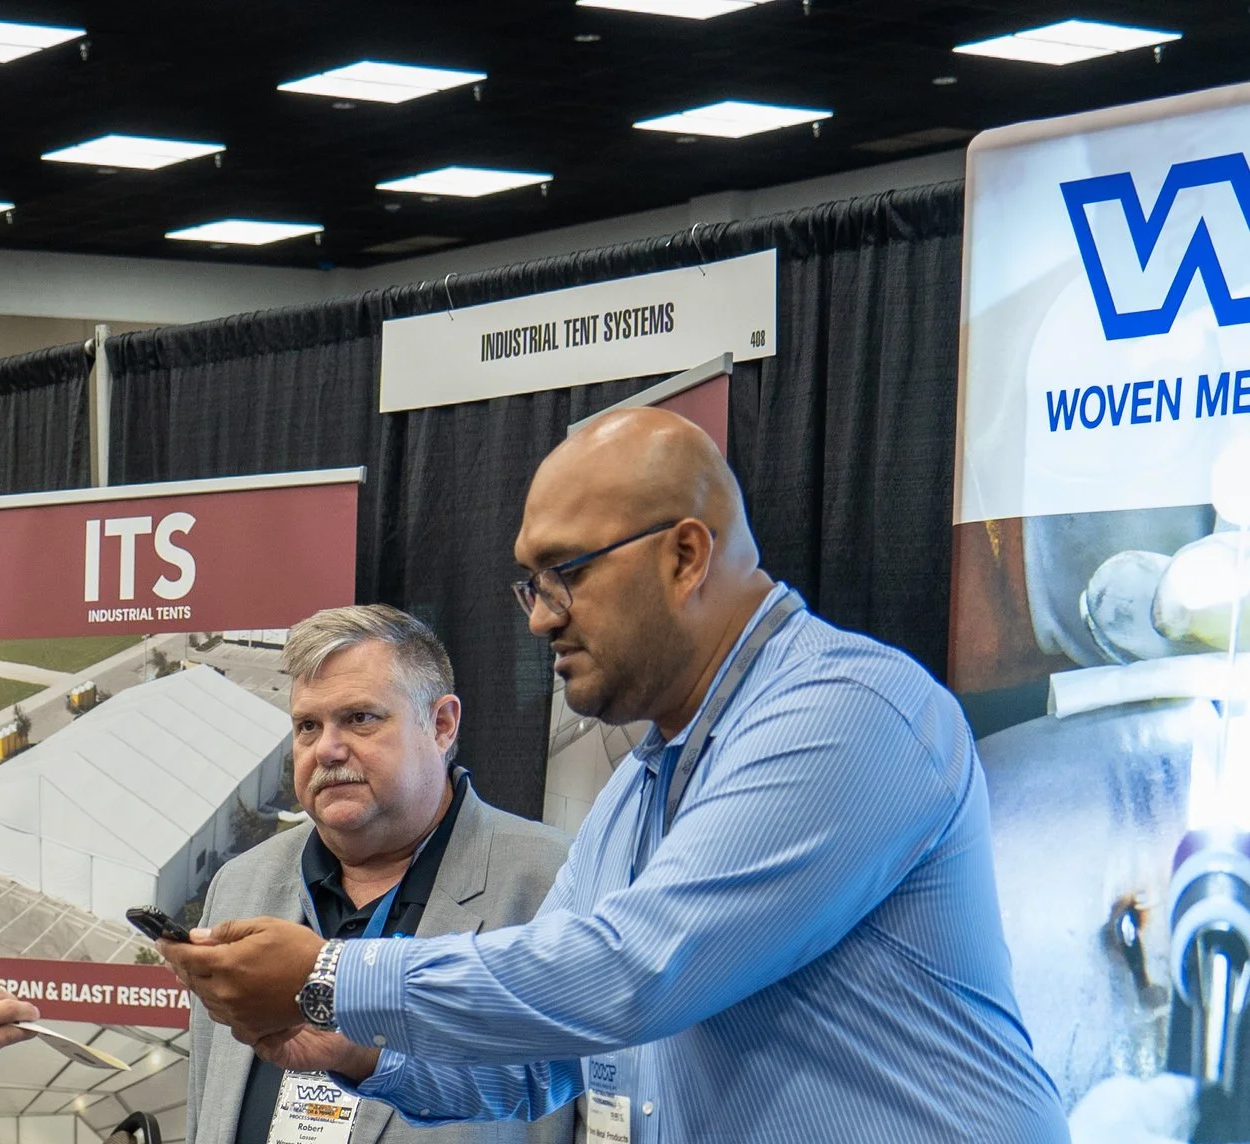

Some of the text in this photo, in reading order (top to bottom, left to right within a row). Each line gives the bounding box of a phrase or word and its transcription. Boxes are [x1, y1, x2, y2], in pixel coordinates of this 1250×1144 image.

[480, 301, 676, 363] INDUSTRIAL TENT SYSTEMS
[750, 329, 766, 348] 408
[1046, 376, 1183, 432] WOVEN
[84, 511, 197, 602] ITS
[88, 605, 191, 623] INDUSTRIAL TENTS
[0, 978, 44, 1000] SPAN
[46, 981, 59, 1001] &
[61, 982, 115, 1005] BLAST
[297, 1122, 324, 1133] Robert
